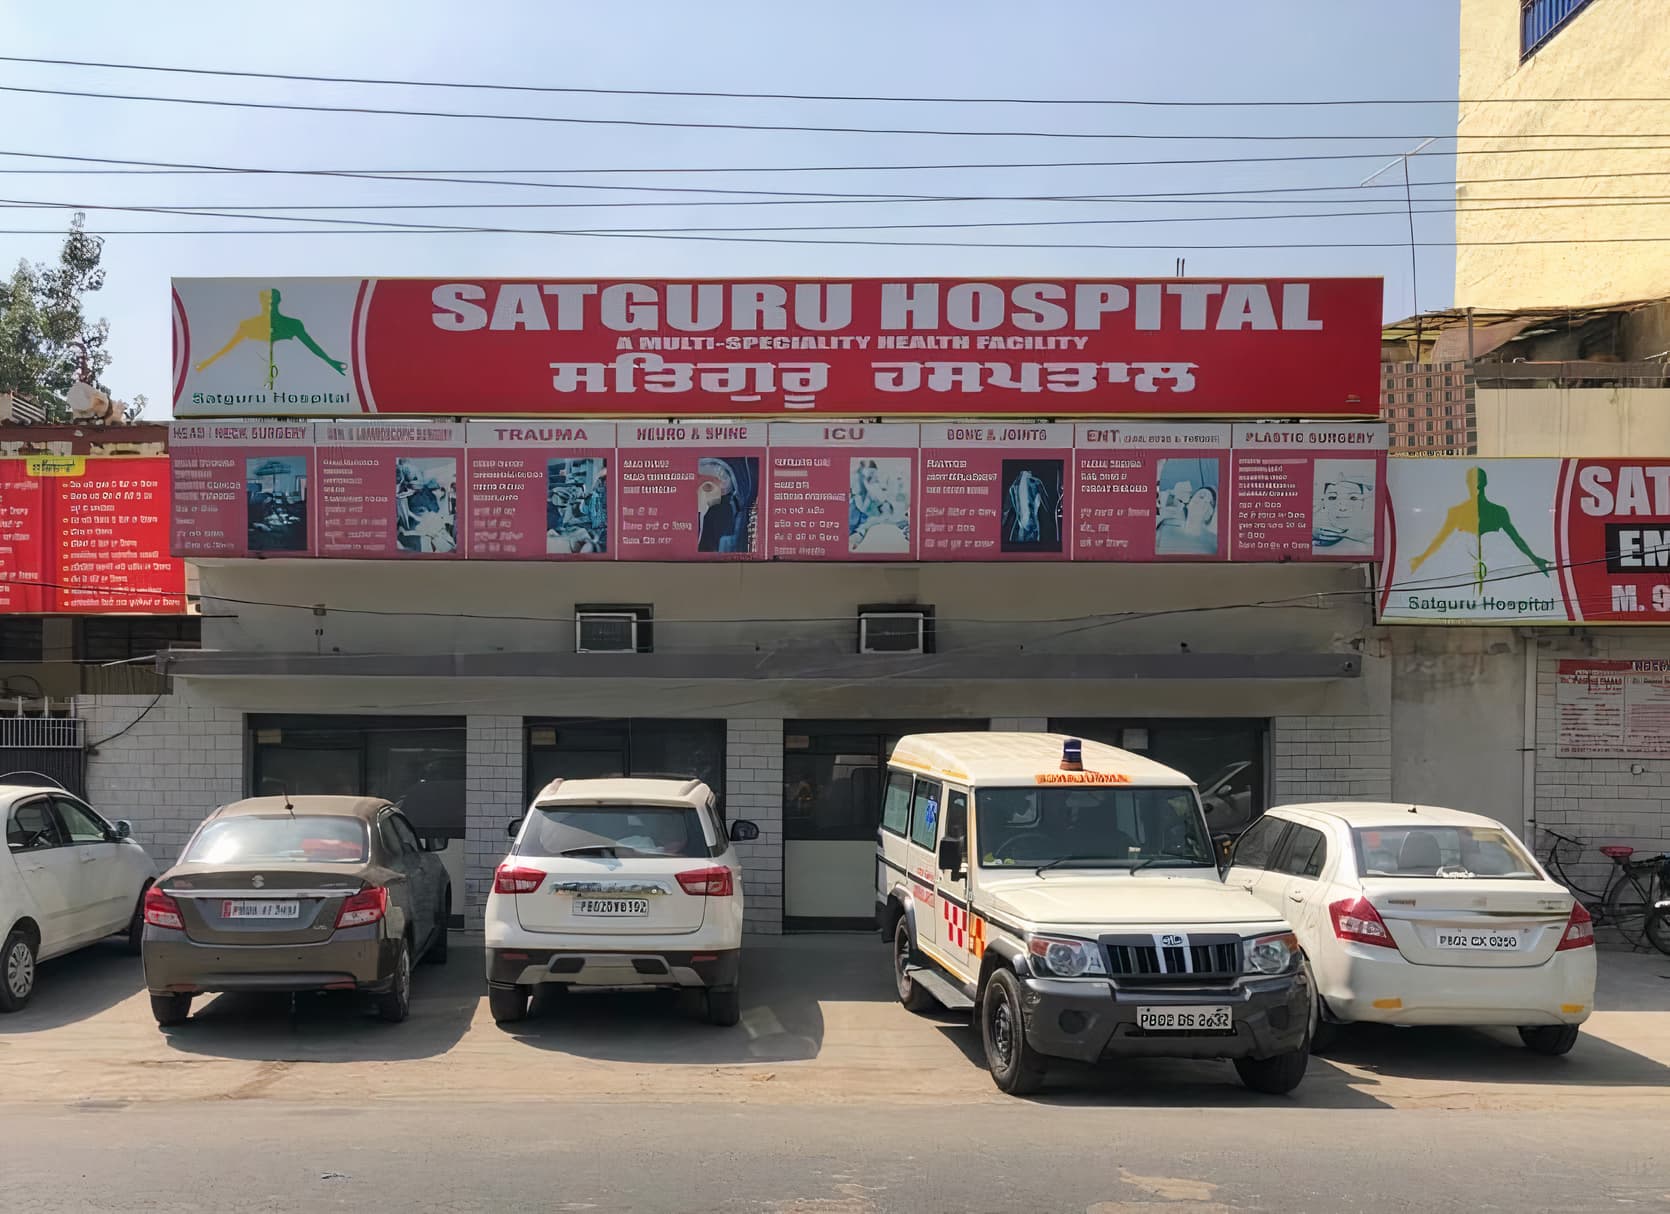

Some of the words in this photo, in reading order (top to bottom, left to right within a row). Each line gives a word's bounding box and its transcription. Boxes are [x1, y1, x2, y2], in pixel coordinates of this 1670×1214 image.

[431, 283, 853, 331] SATGURU
[880, 282, 1323, 331] HOSPITAL
[616, 336, 634, 350] A
[640, 336, 870, 351] MULTI-SPECIALITY
[877, 335, 970, 350] HEALTH
[976, 335, 1089, 350] FACILITY
[549, 352, 832, 409] ਸਤਿਗੁਰੂ
[871, 361, 1199, 393] ਹਸਪਤਾਲ
[192, 392, 267, 406] Satguru
[273, 392, 350, 405] Hospital
[494, 428, 588, 441] TRAUMA
[705, 427, 748, 441] SPINE
[823, 427, 865, 441] ICU
[1087, 430, 1120, 443] ENT
[1408, 596, 1476, 613] Satguru
[1482, 596, 1555, 614] Hospital
